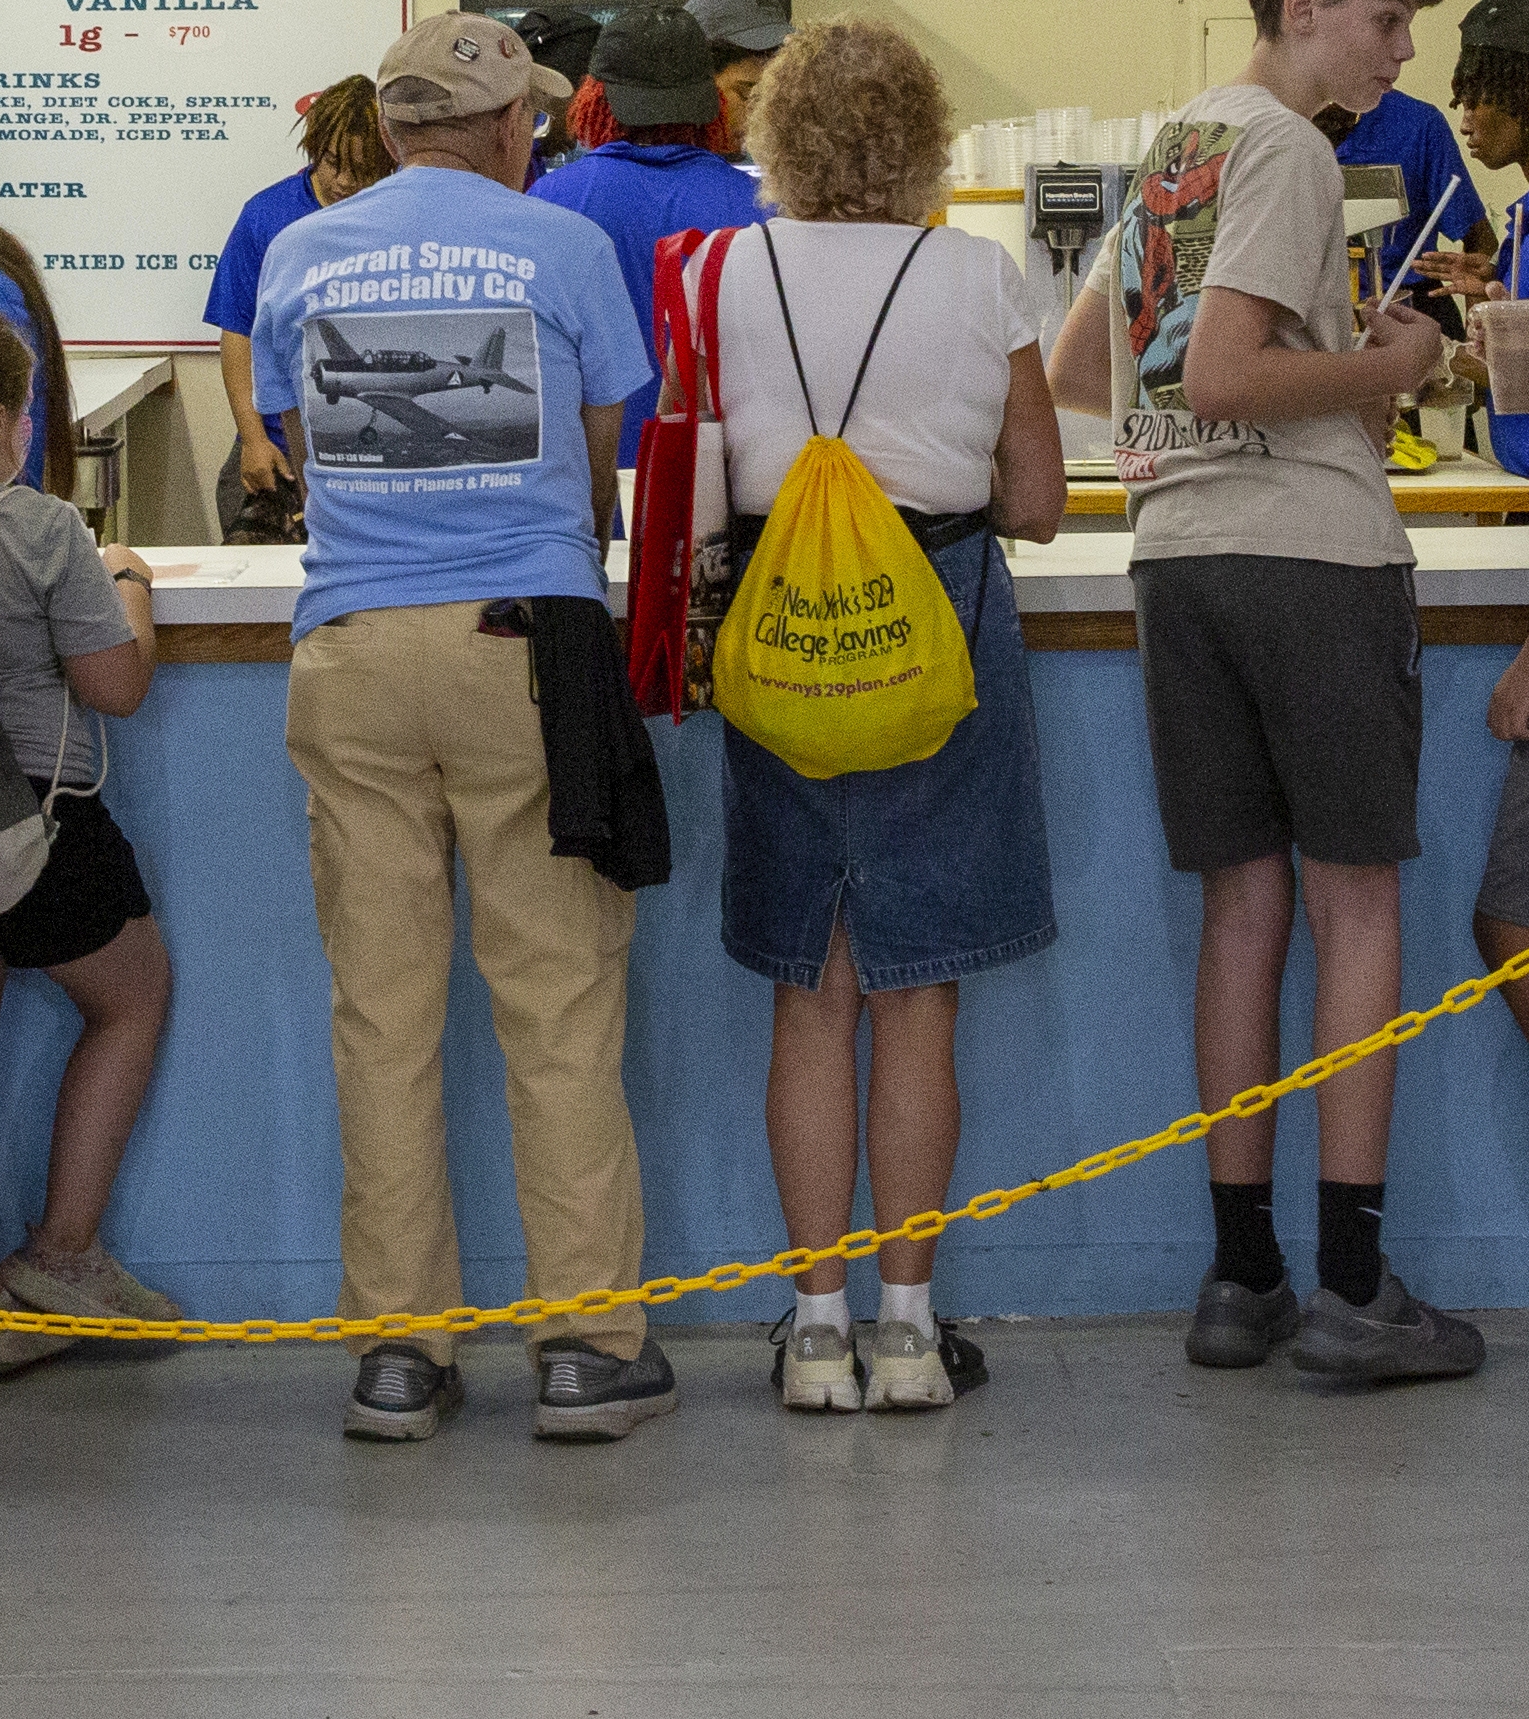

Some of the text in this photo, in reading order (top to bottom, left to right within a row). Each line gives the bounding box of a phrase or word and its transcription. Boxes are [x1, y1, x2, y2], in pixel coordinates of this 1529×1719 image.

[42, 96, 98, 108] DIET
[108, 96, 175, 110] COKE,
[185, 96, 277, 111] SPRITE,
[80, 113, 118, 124] DR.
[128, 113, 227, 126] PEPPER,
[116, 129, 171, 141] ICED
[181, 129, 229, 141] TEA
[43, 254, 125, 271] FRIED
[135, 254, 182, 271] ICE
[300, 241, 536, 290] Aircraft Spruce
[324, 271, 476, 307] Specialty
[483, 271, 533, 304] Co.
[391, 479, 410, 492] for
[414, 477, 463, 492] Planes
[480, 473, 522, 488] Pilots
[782, 583, 821, 620] New
[755, 612, 911, 662] College Savings
[819, 645, 893, 665] PROGRAM
